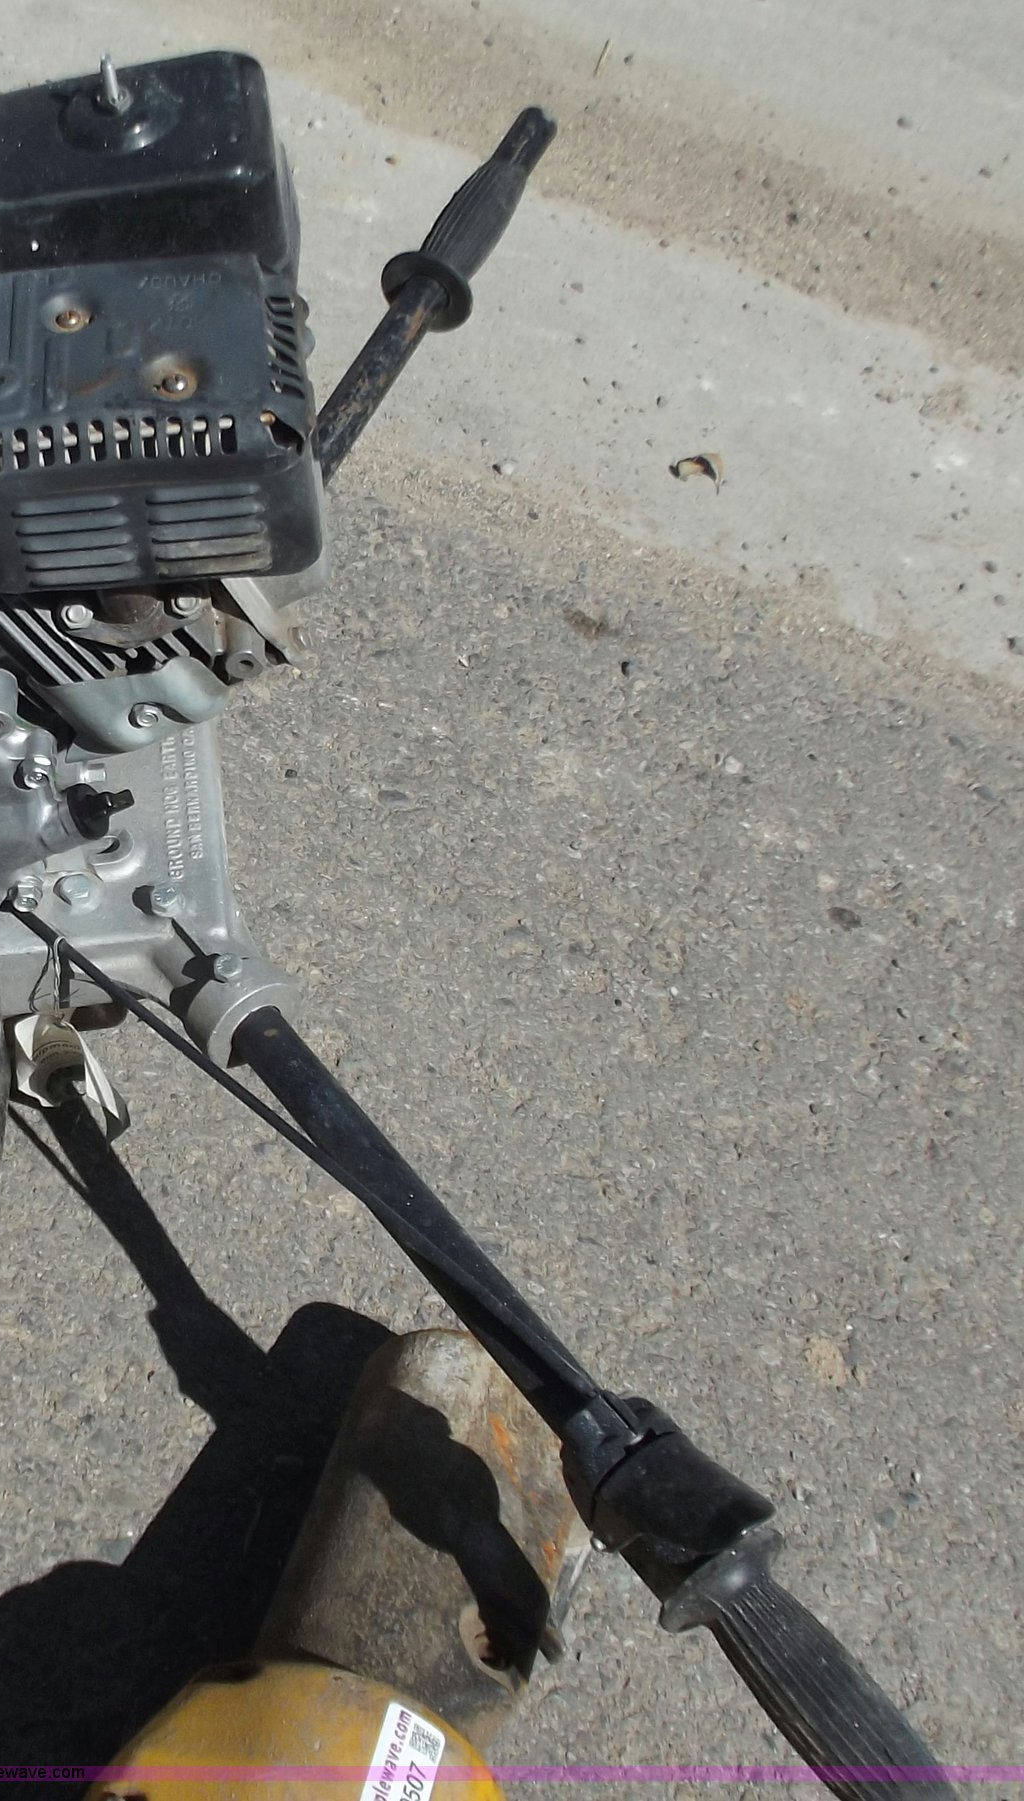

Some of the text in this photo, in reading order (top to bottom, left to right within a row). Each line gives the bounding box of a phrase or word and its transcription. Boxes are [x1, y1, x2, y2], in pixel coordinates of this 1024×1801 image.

[163, 786, 180, 814] HOG
[165, 818, 184, 880] GROUND
[188, 834, 204, 860] SAN
[398, 1760, 427, 1801] 507
